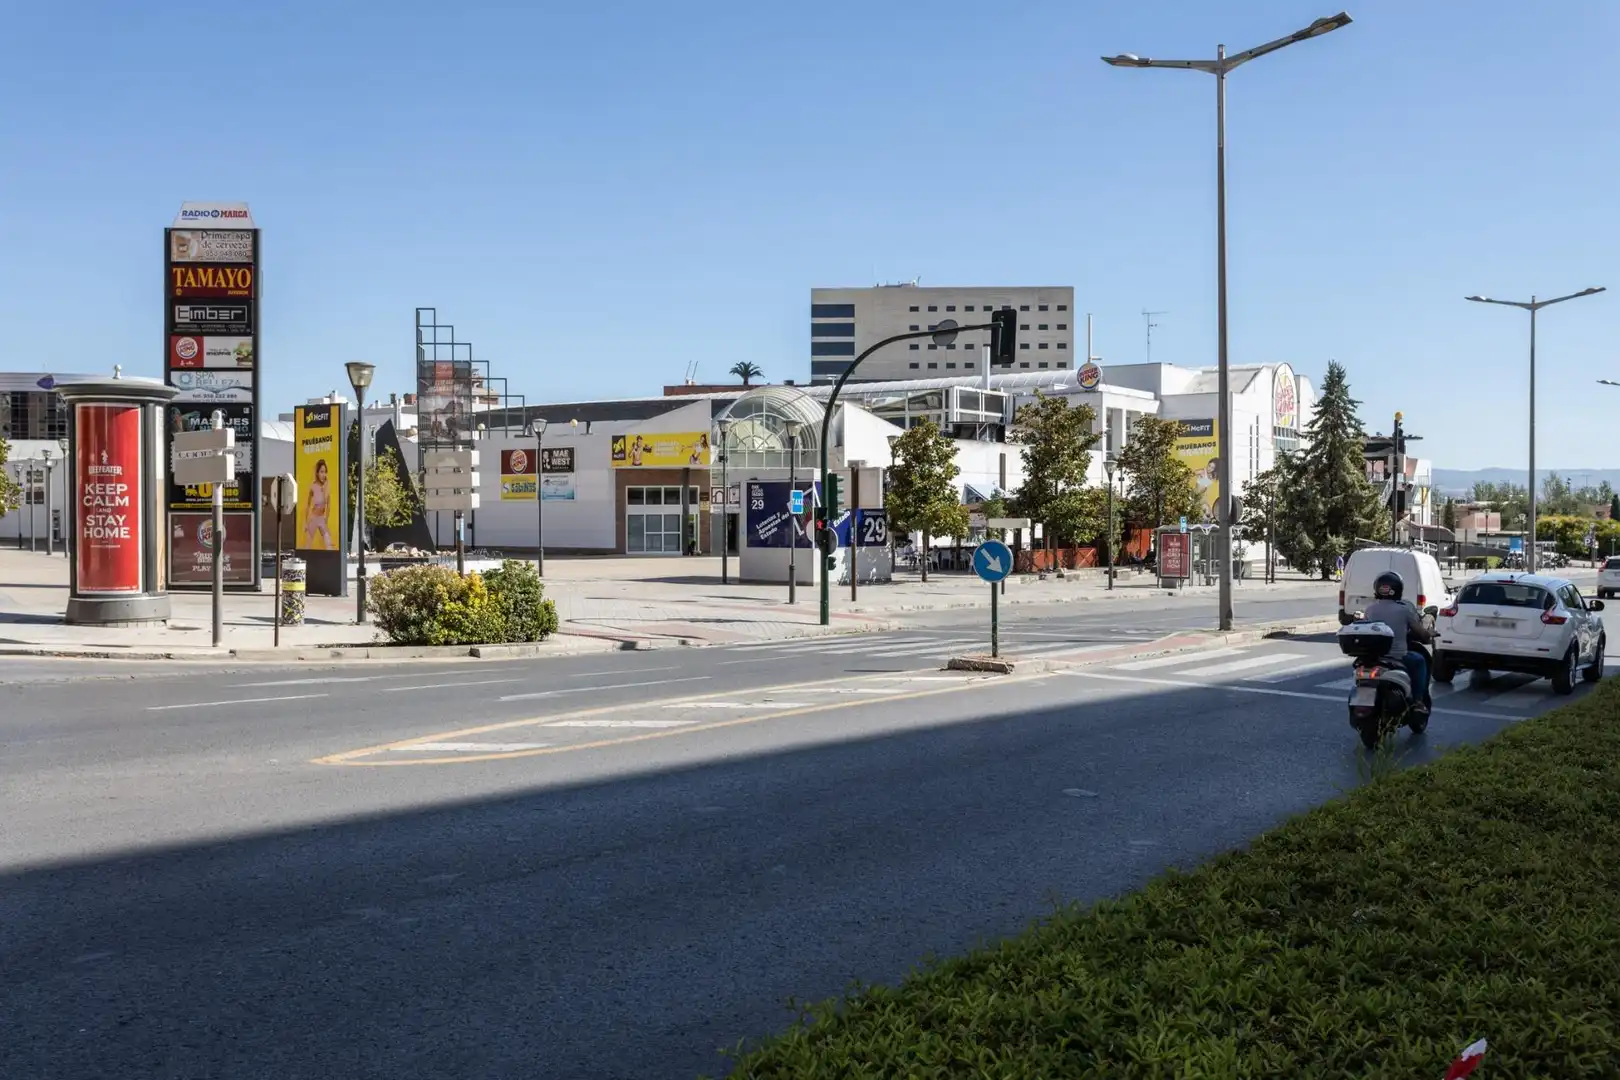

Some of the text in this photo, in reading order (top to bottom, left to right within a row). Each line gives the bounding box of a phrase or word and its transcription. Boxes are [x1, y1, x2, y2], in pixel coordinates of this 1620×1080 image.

[181, 209, 248, 218] RADIO MARCA
[201, 231, 251, 241] Primer spa
[201, 240, 212, 249] de
[173, 267, 252, 288] TAMAYO
[196, 371, 215, 380] SPA
[1080, 371, 1099, 384] KING
[313, 412, 329, 421] McFIT
[1190, 424, 1211, 433] McFIT
[302, 435, 333, 447] PRUÉBANOS
[1176, 441, 1217, 451] PRUÉBANOS
[553, 449, 570, 458] MAE
[551, 457, 571, 466] WEST
[88, 465, 123, 475] BEEFEATER
[85, 483, 128, 495] KEEP
[83, 495, 130, 507] CALM
[751, 499, 765, 510] 29
[791, 498, 804, 506] TAXI
[86, 514, 127, 527] STAY
[758, 517, 782, 536] Apuestas
[864, 516, 886, 542] 29
[83, 526, 131, 539] HOME
[760, 526, 778, 541] Estado
[1584, 538, 1591, 546] P
